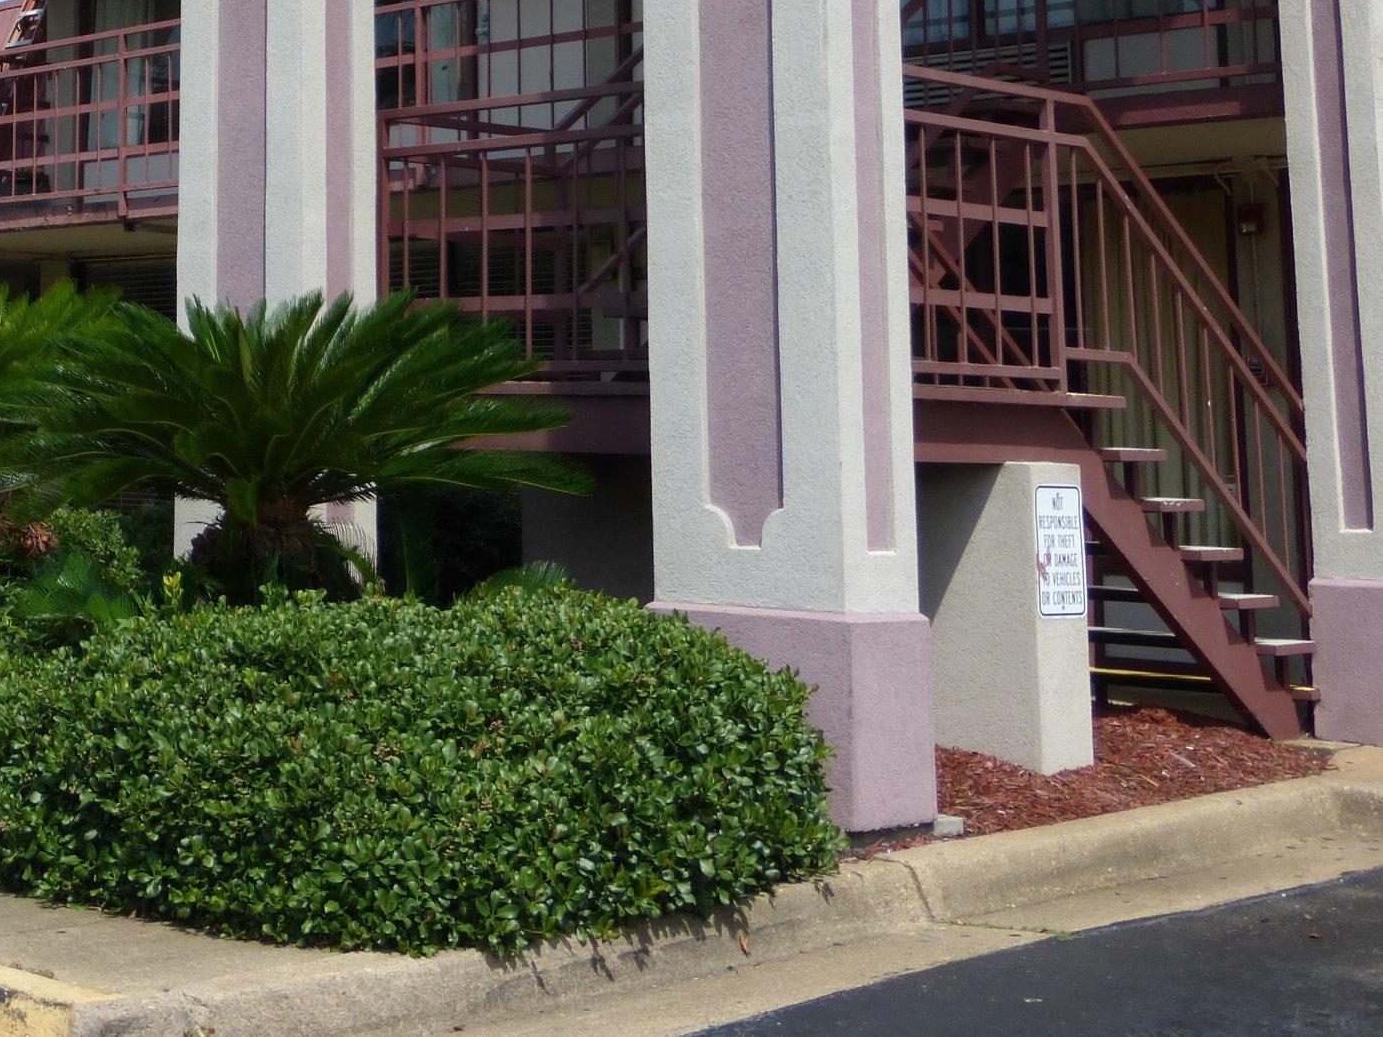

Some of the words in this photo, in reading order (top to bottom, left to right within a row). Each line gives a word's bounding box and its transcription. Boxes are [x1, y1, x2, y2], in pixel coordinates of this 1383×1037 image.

[1052, 496, 1063, 510] NOT
[1038, 515, 1078, 529] RESPONSIBLE
[1044, 534, 1055, 548] FOR
[1057, 534, 1075, 548] THEFT
[1044, 553, 1052, 567] OR
[1055, 553, 1078, 567] DAMAGE
[1053, 572, 1080, 586] VEHICLES
[1042, 591, 1051, 605] OR
[1053, 591, 1083, 605] CONTENTS
